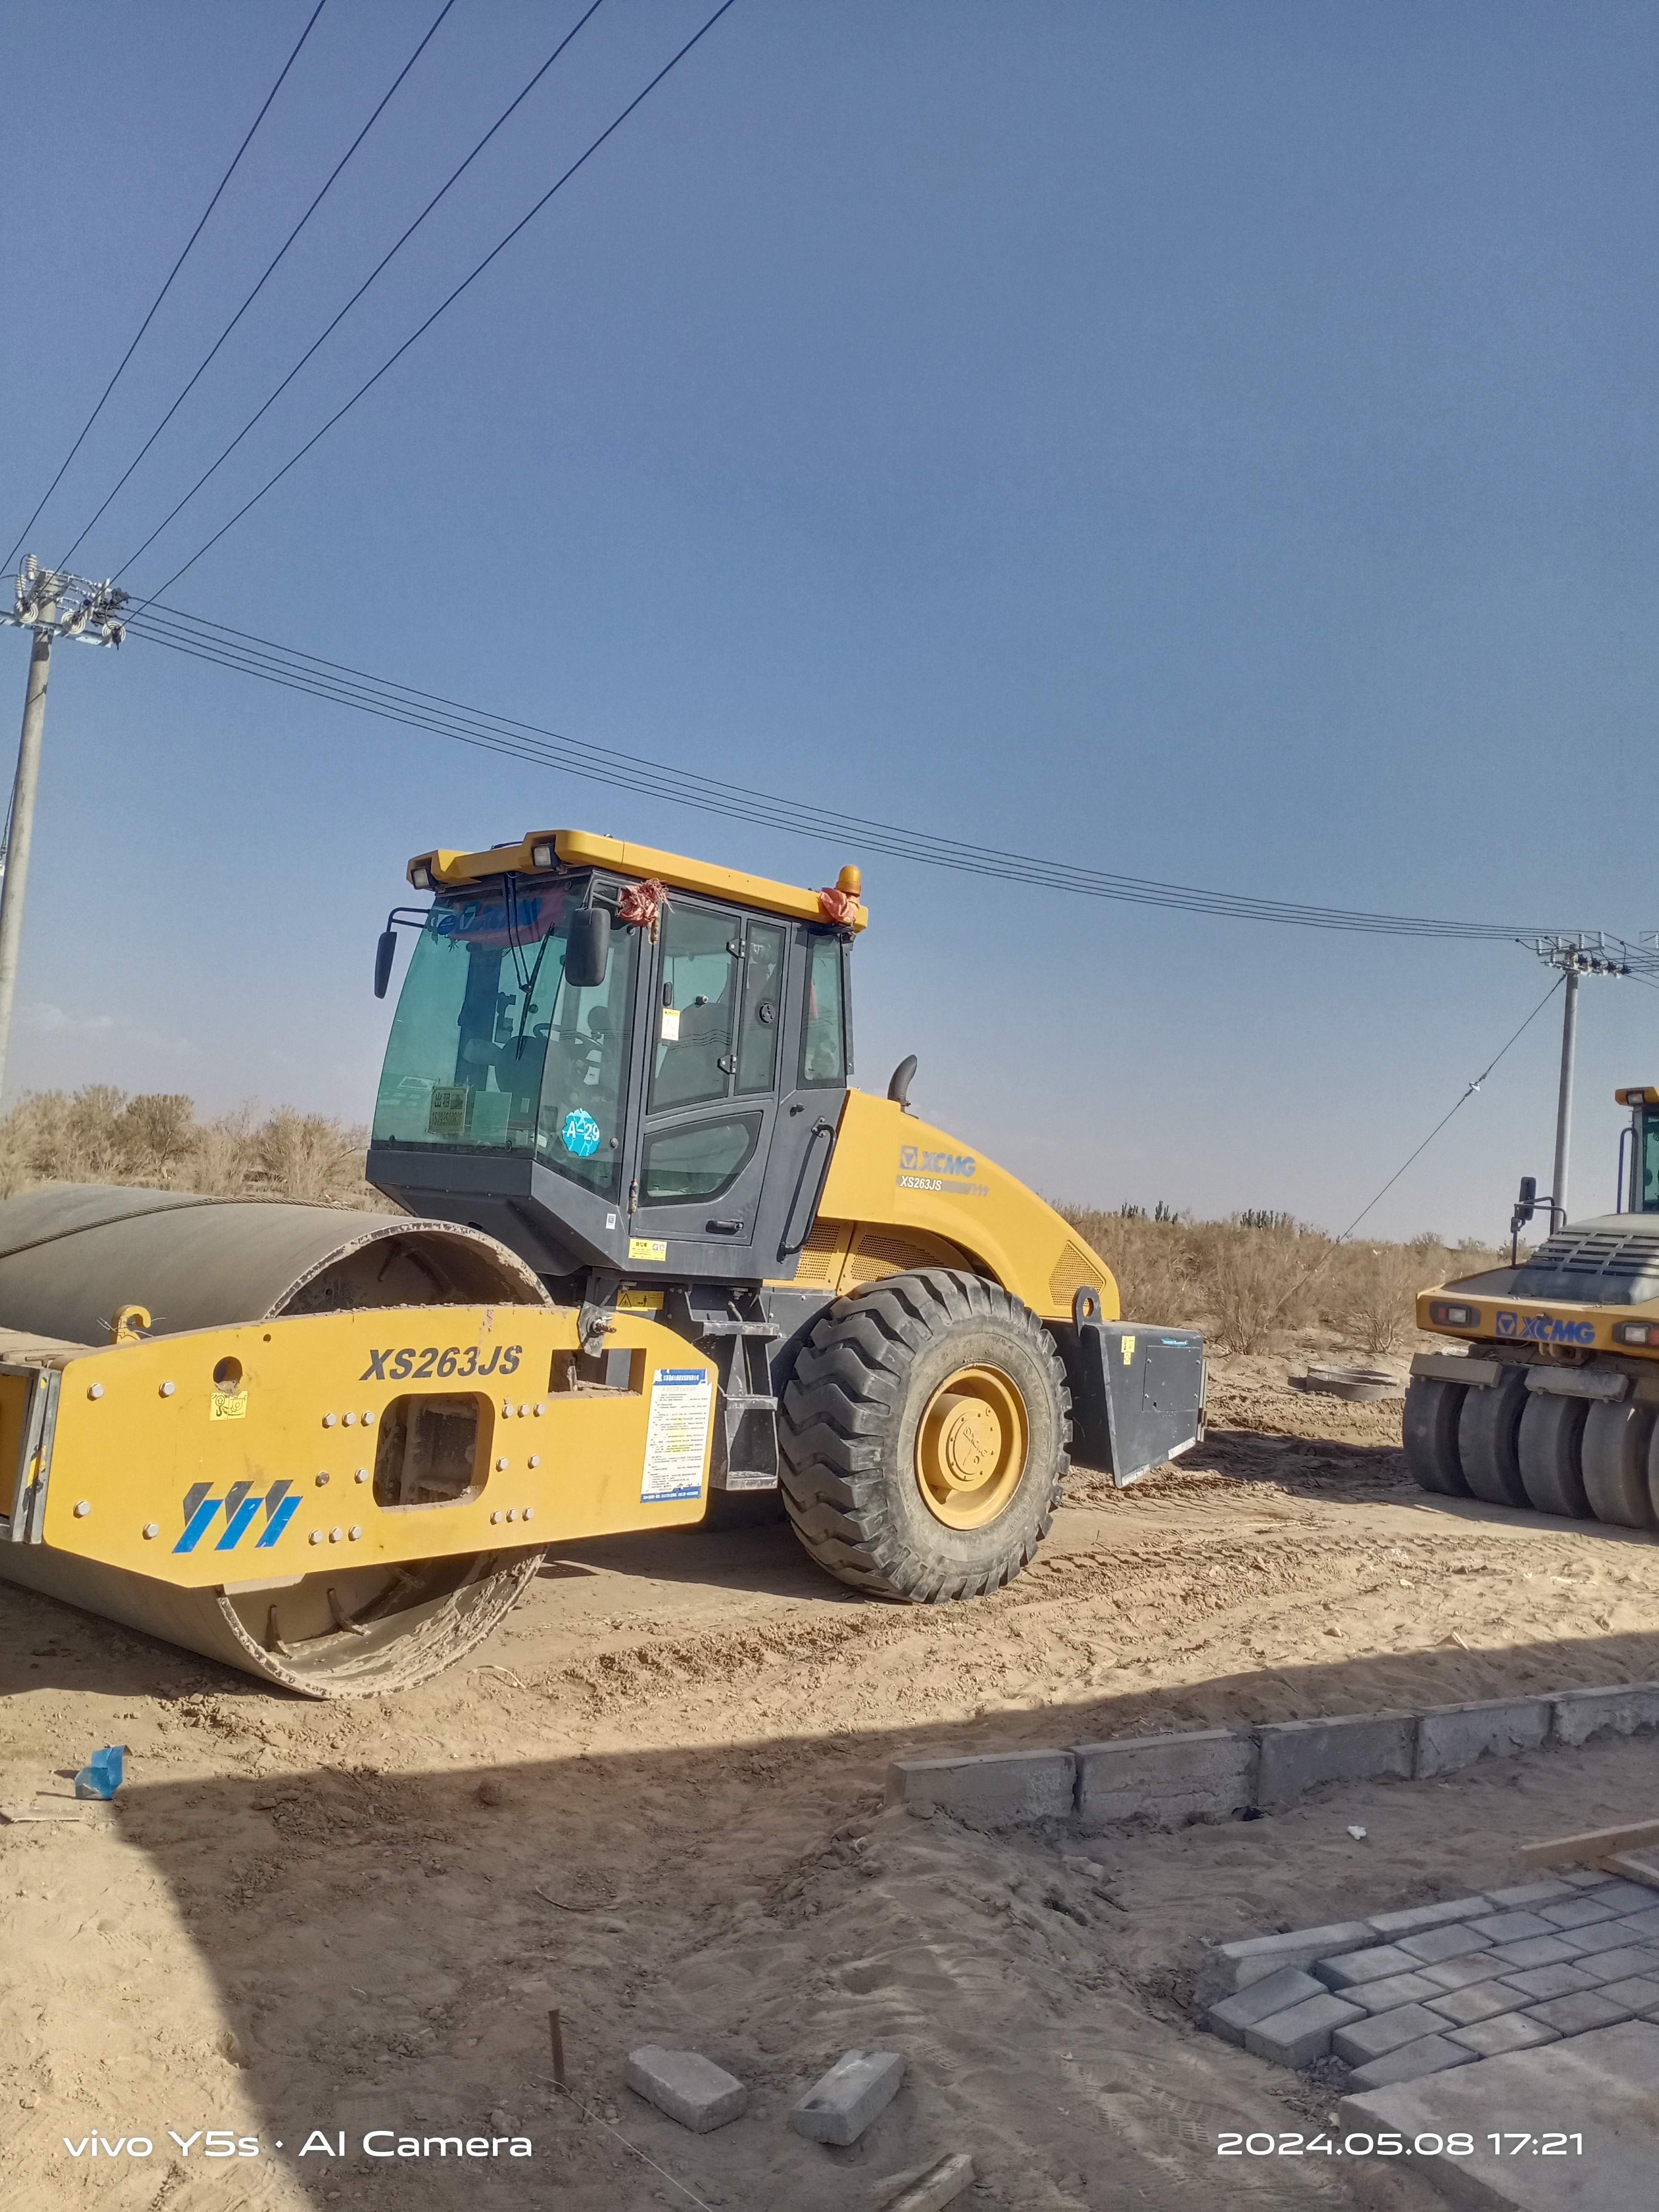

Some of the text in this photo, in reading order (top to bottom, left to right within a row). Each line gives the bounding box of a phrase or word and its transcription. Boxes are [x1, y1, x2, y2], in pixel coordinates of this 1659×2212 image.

[566, 1120, 600, 1142] A-29
[919, 1150, 976, 1178] XCMG
[900, 1175, 942, 1191] XS263JS
[1517, 1316, 1596, 1344] XCMG
[358, 1344, 523, 1381] XS263JS
